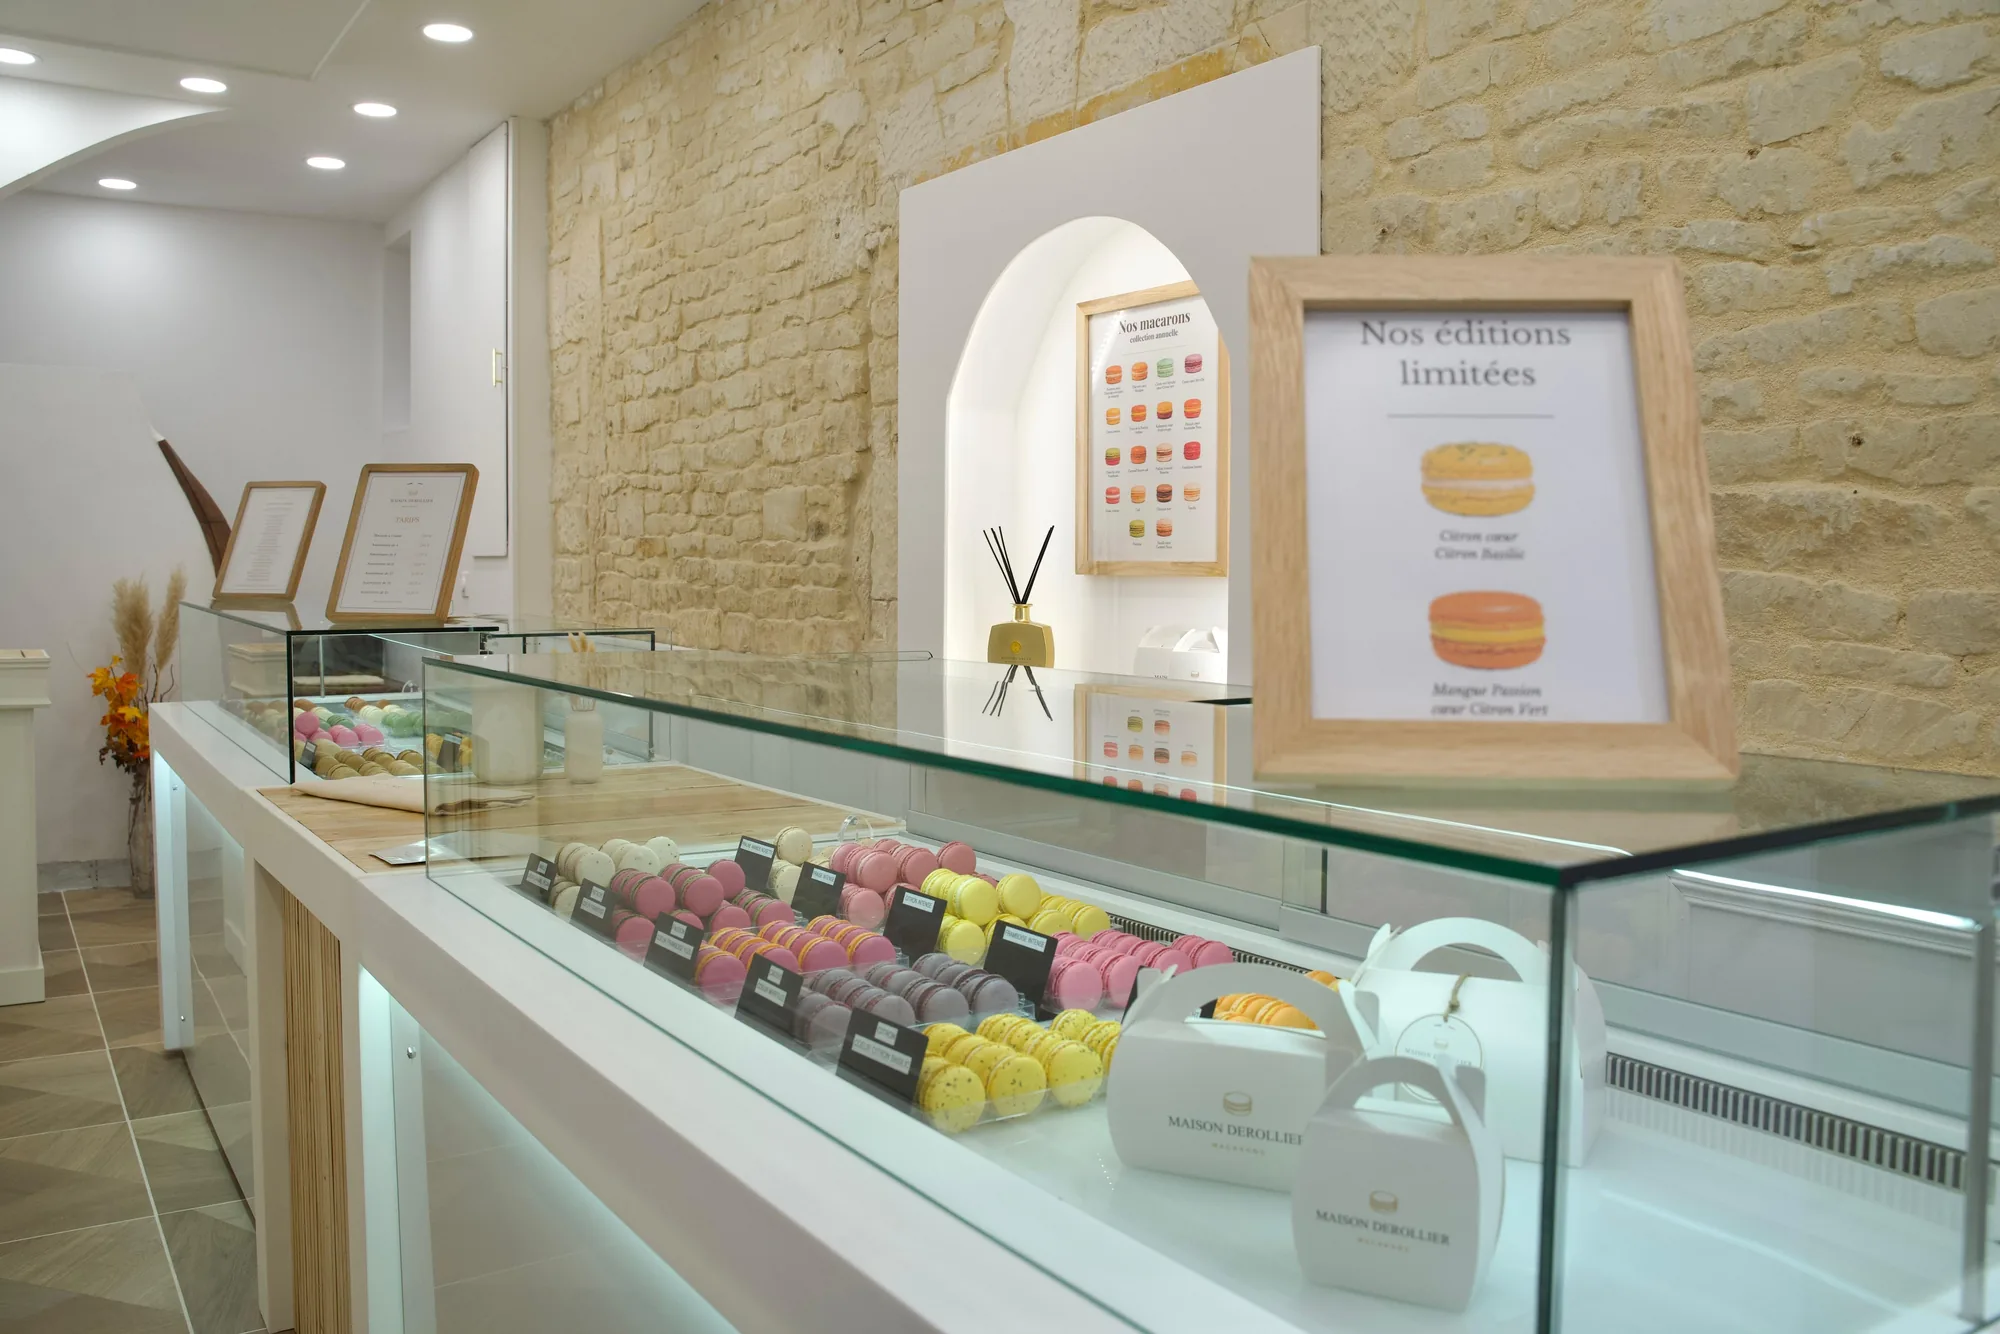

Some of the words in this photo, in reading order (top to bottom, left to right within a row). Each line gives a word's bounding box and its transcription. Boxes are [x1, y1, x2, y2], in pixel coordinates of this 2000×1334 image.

[1119, 319, 1138, 334] Nos
[1140, 312, 1191, 331] macarons
[1129, 333, 1155, 344] collection
[1155, 328, 1179, 340] annuelle
[1361, 320, 1424, 345] Nos
[1435, 319, 1572, 346] éditions
[1400, 359, 1536, 387] limitées
[1440, 530, 1482, 542] Citron
[1435, 547, 1478, 559] Citron
[1491, 682, 1542, 697] Passion
[1469, 702, 1514, 716] Citron
[1519, 701, 1549, 716] Vert
[1168, 1115, 1223, 1134] MAISON
[1316, 1209, 1369, 1229] MAISON
[1372, 1220, 1450, 1246] DEROLLIER
